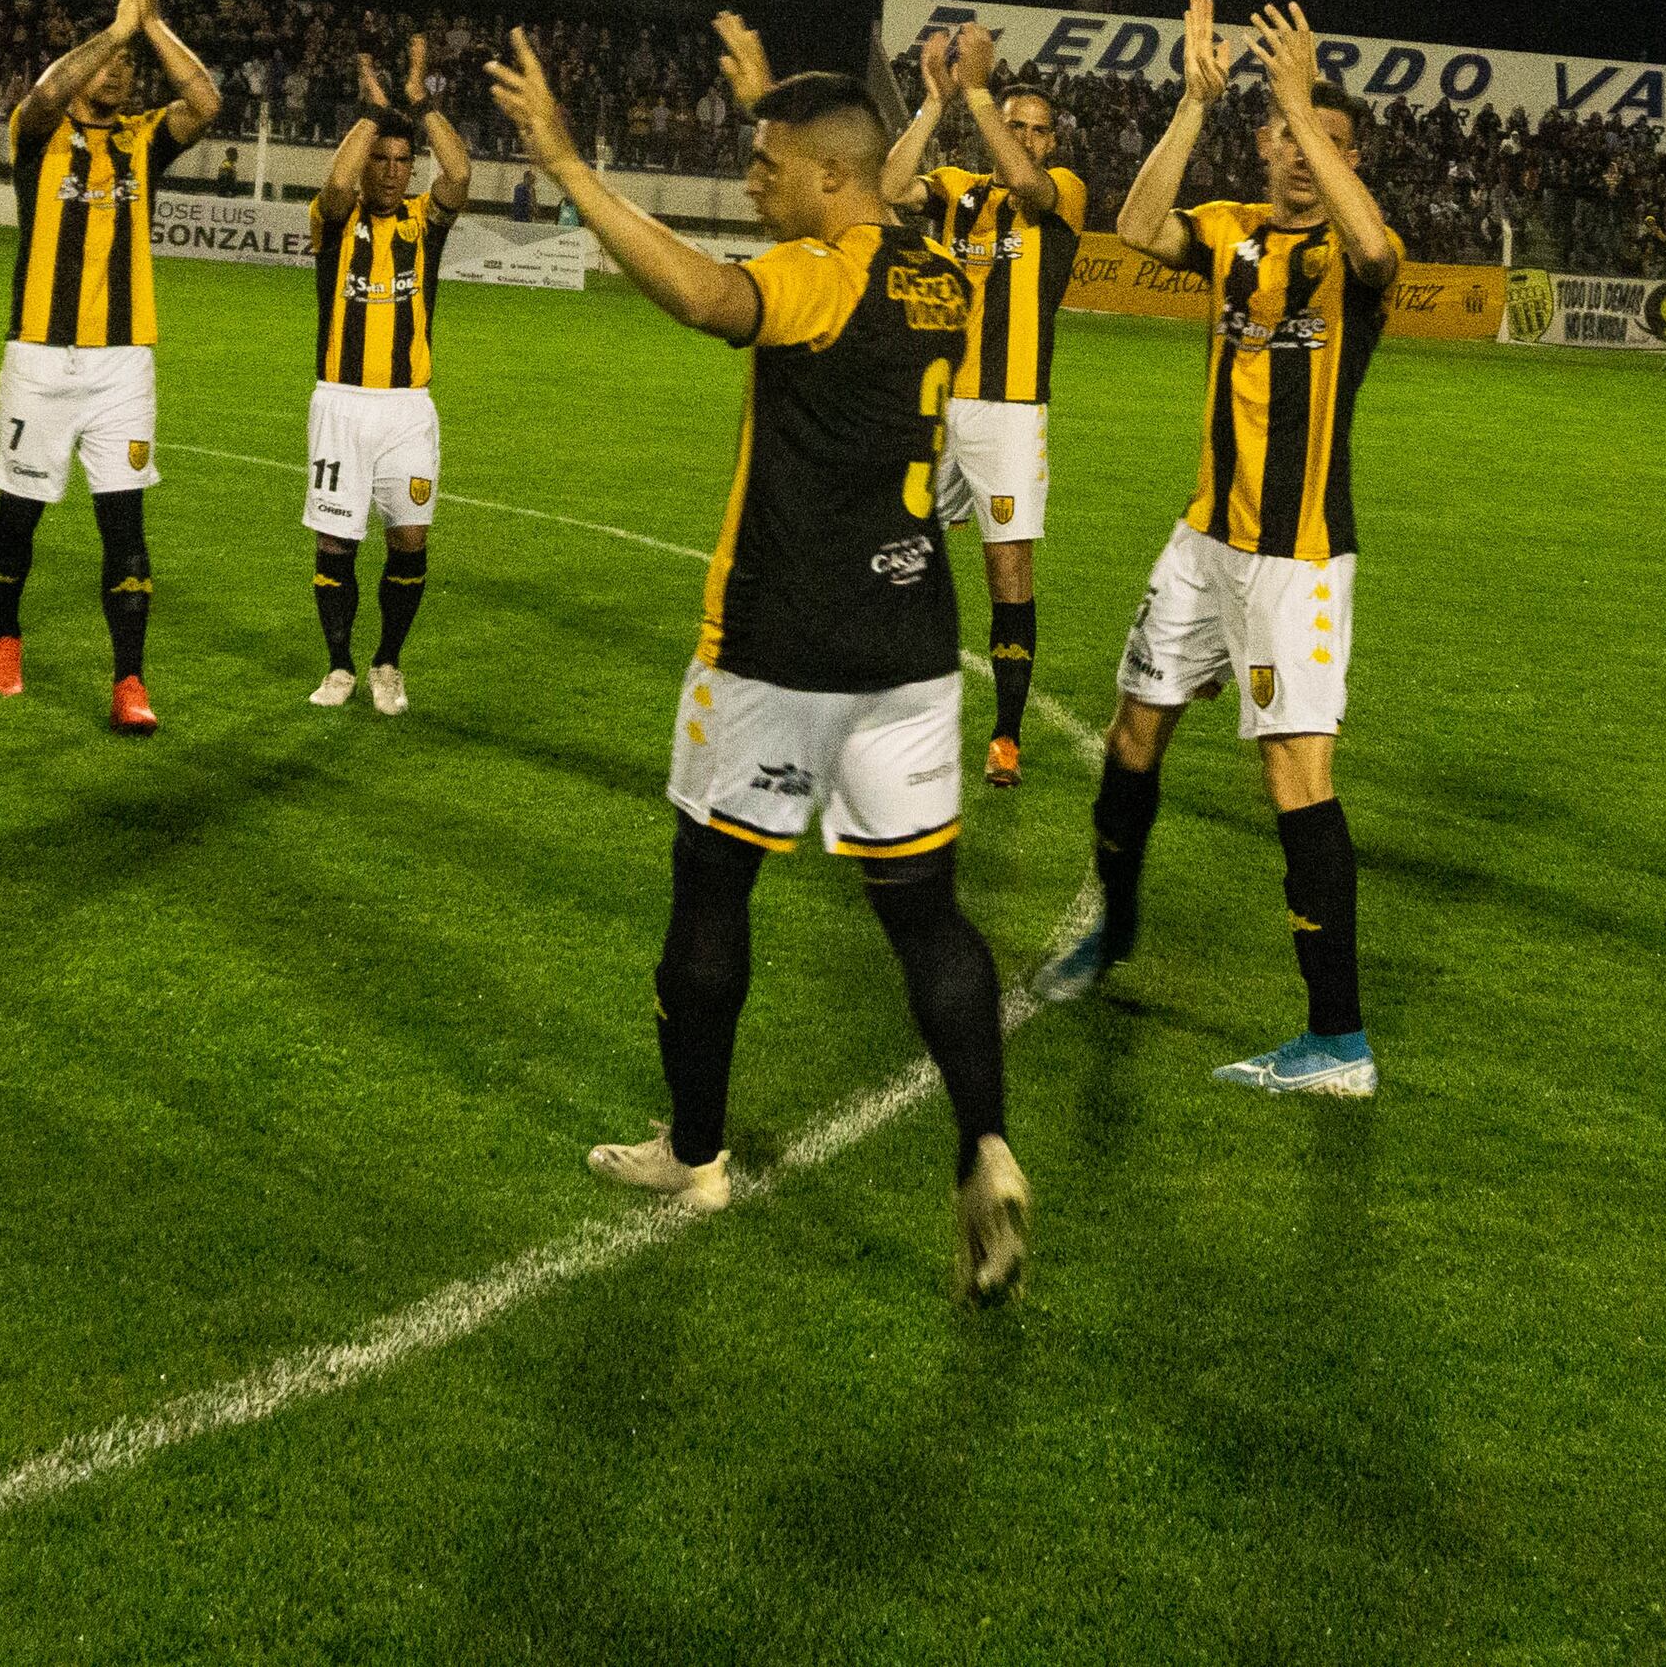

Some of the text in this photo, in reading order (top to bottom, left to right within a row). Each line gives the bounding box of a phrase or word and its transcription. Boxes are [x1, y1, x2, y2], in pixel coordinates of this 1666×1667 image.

[211, 206, 257, 226] LUIS
[151, 222, 316, 257] GONZALEZ
[1394, 283, 1438, 313] VEZ
[8, 417, 25, 451] 7
[313, 457, 341, 492] 11
[317, 503, 353, 518] ORBIS
